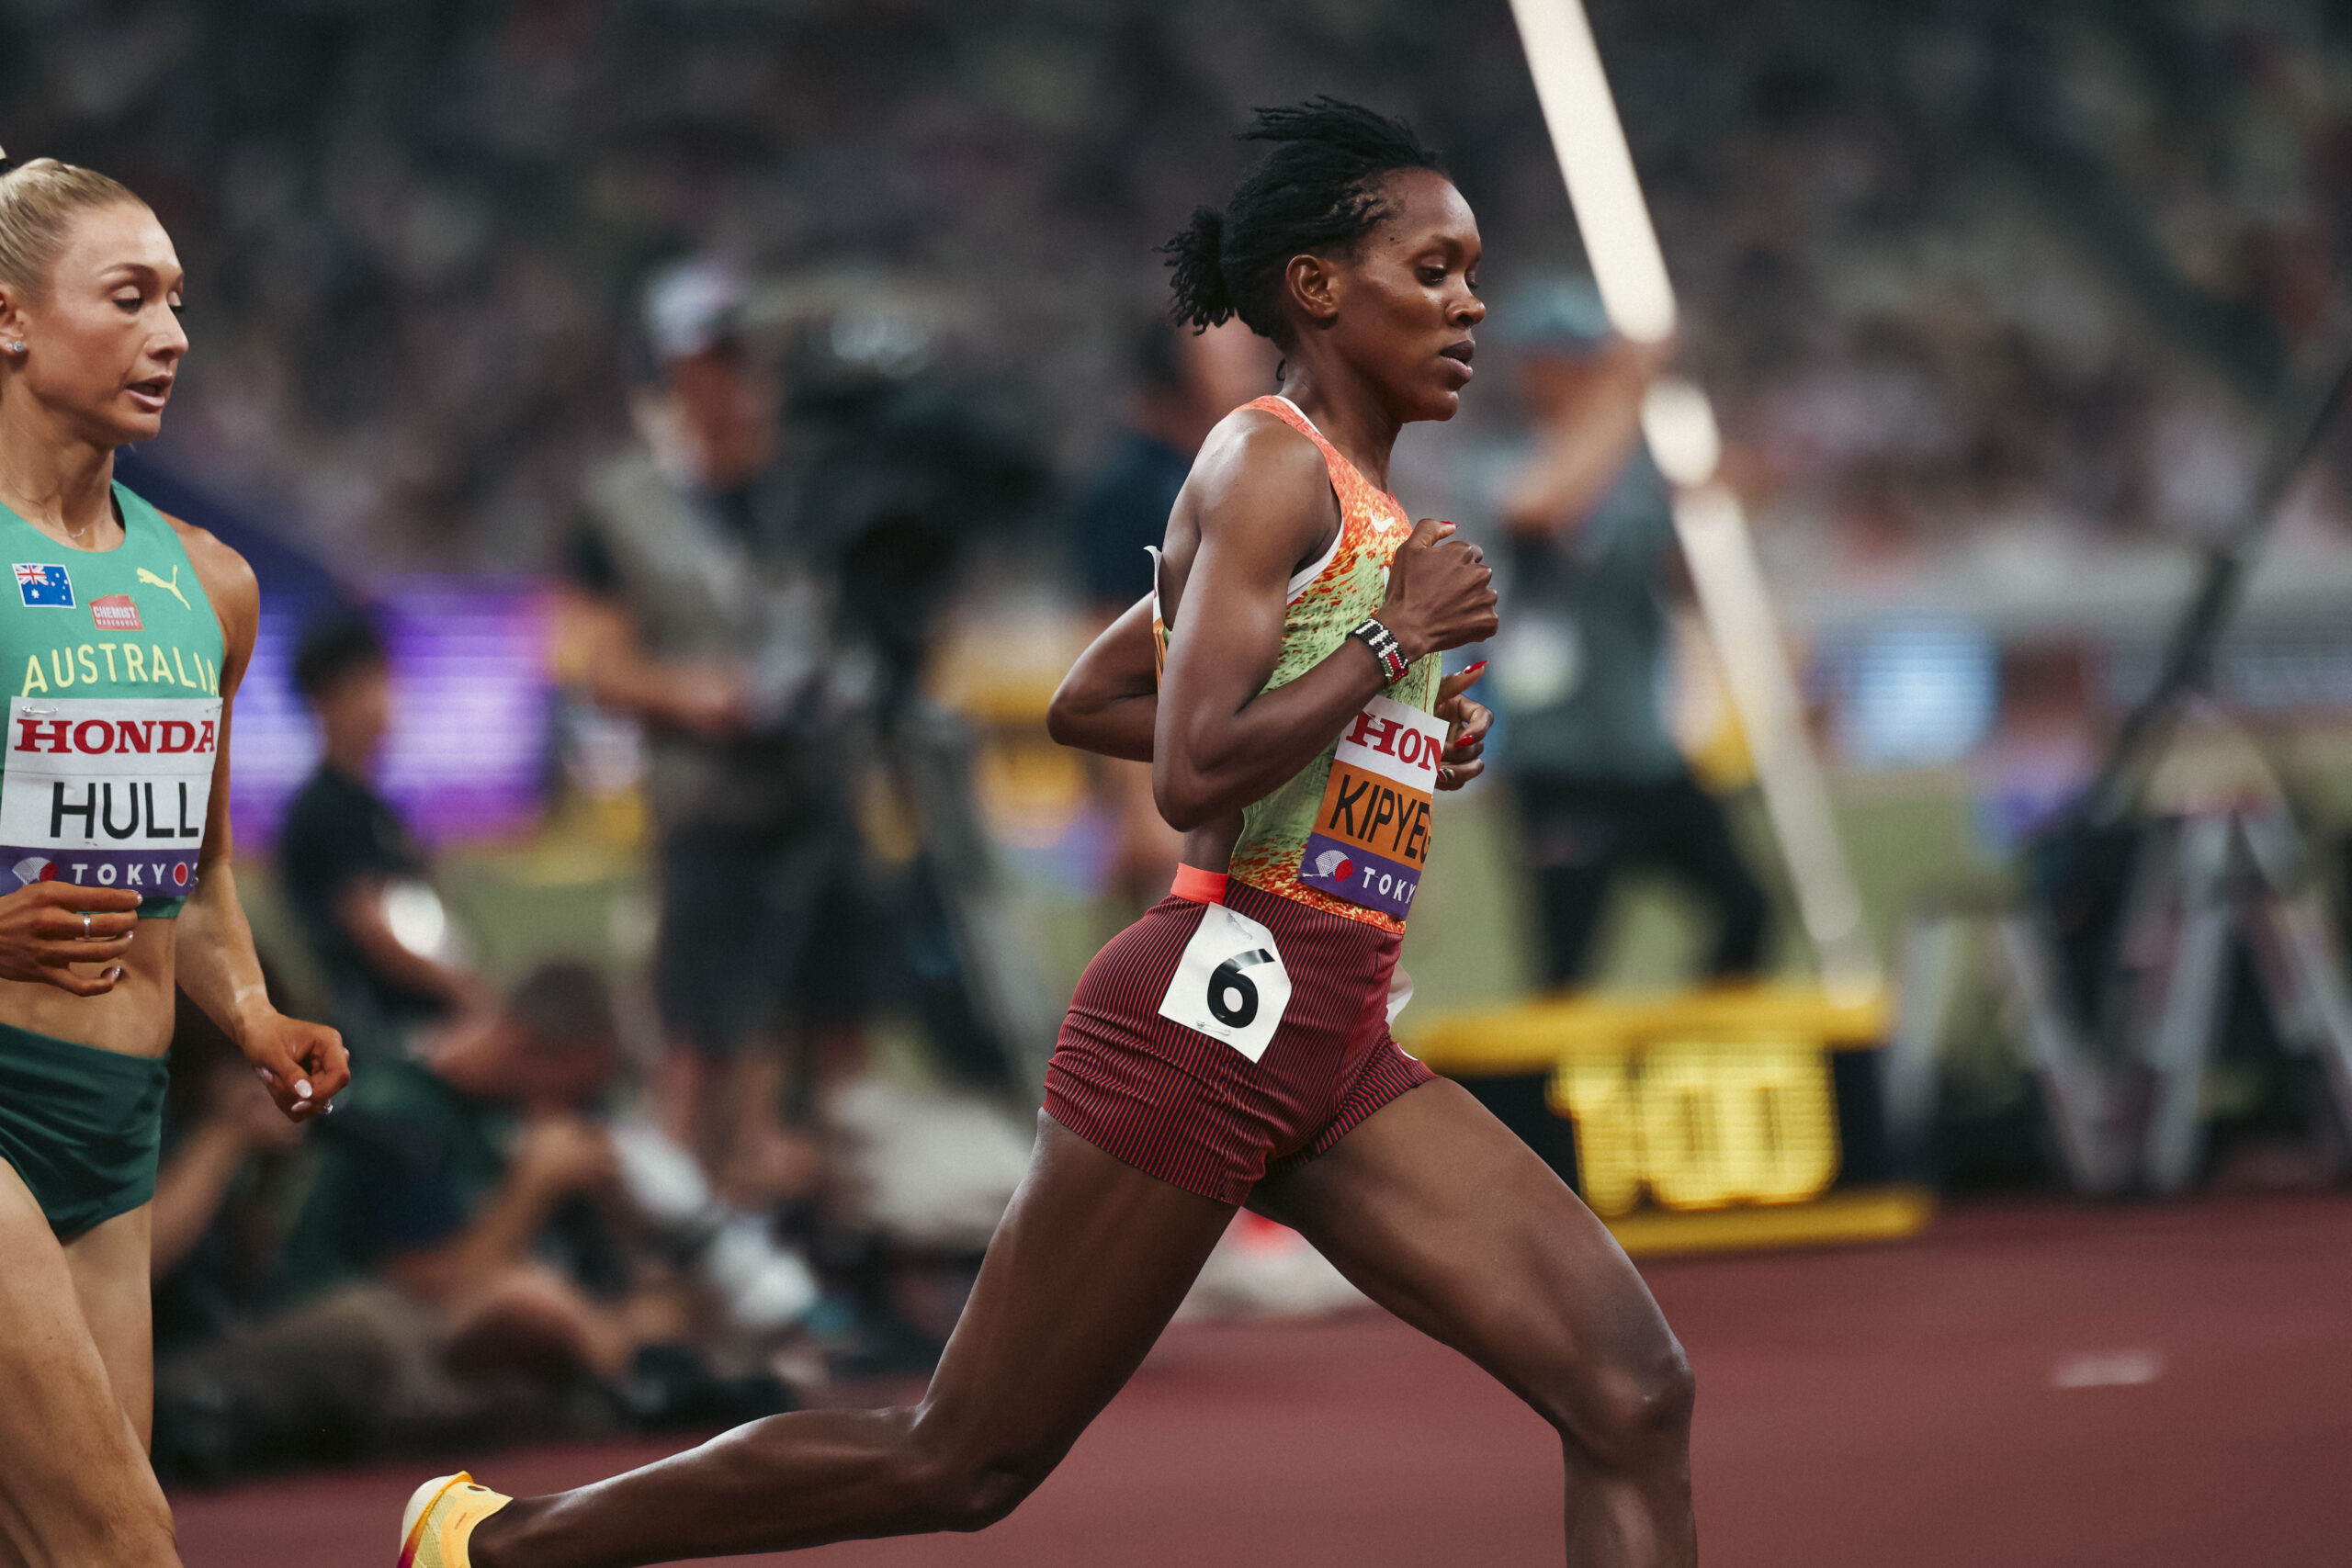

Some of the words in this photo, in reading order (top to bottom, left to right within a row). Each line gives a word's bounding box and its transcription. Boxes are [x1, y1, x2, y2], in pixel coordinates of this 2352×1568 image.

[93, 605, 136, 619] CHEMIST
[96, 618, 141, 626] WAREHOUSE
[21, 642, 220, 699] AUSTRALIA
[14, 718, 215, 754] HONDA
[50, 782, 198, 840] HULL
[1207, 948, 1275, 1028] 6
